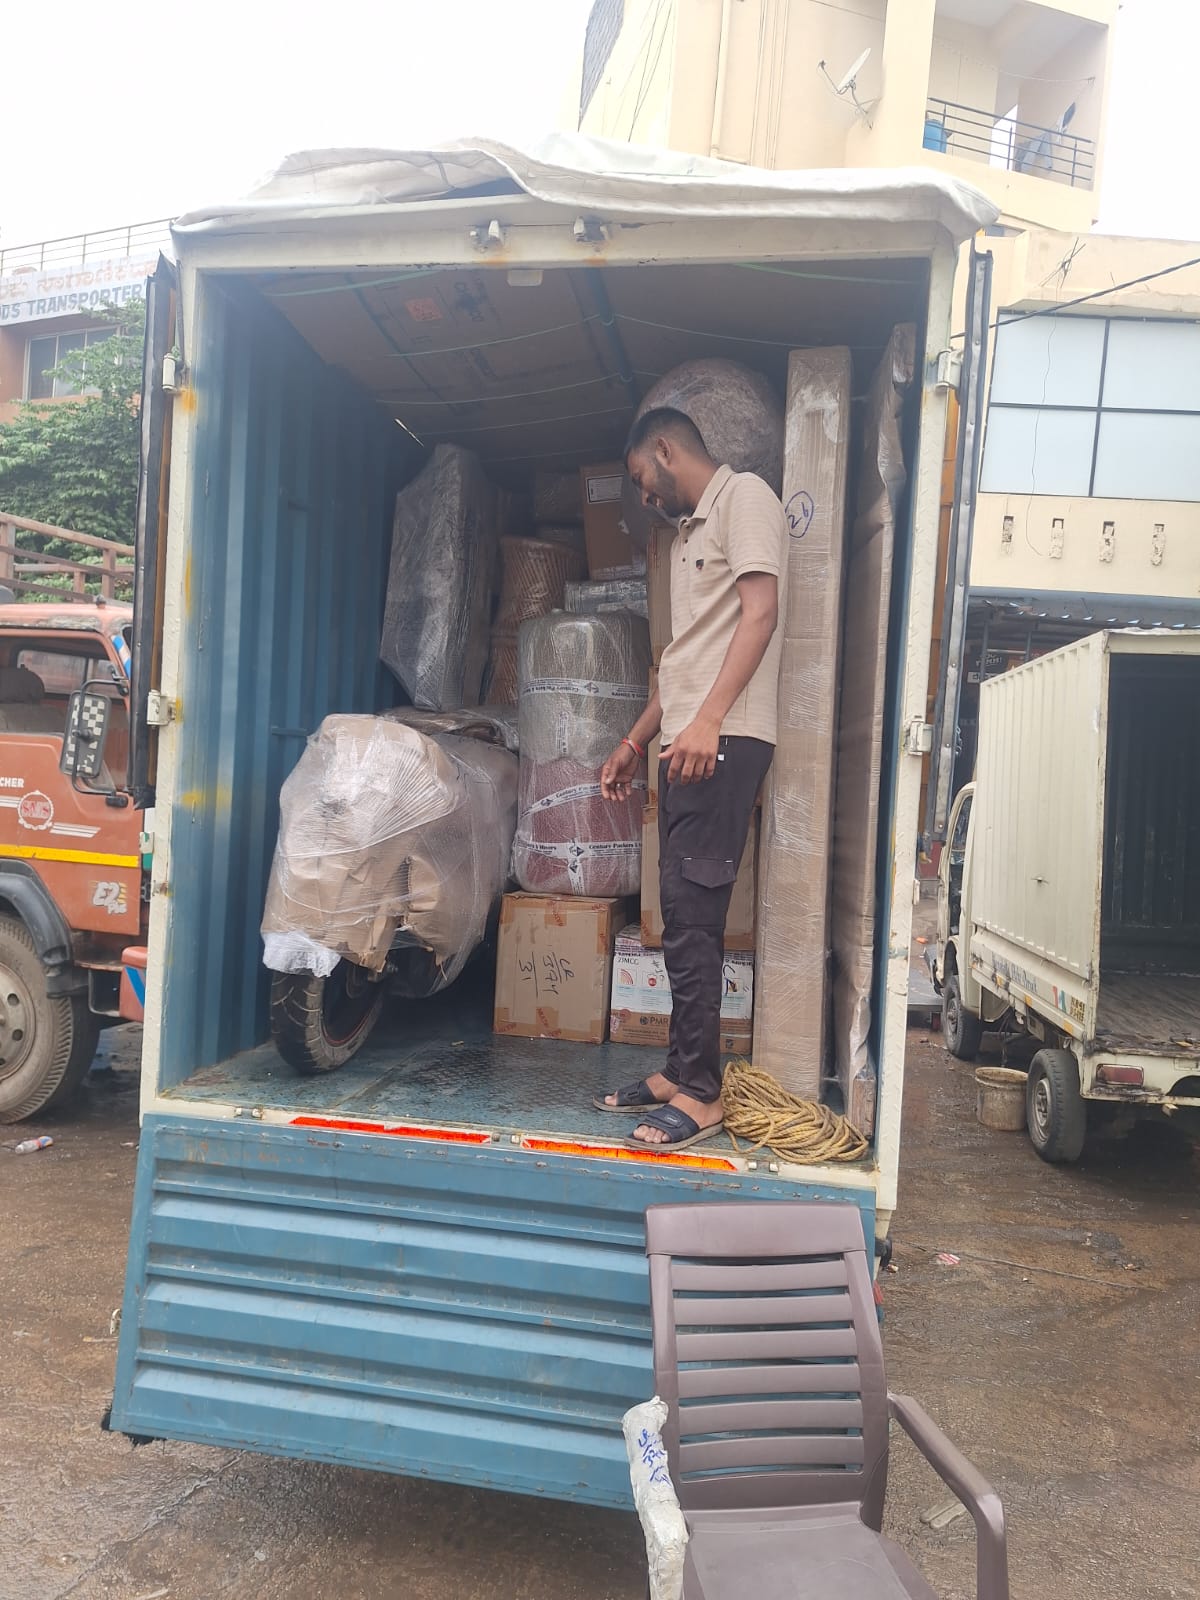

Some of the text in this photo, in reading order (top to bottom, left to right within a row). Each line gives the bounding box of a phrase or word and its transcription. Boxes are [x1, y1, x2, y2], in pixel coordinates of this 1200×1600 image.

[0, 281, 148, 320] DS TRANSPORTER
[0, 777, 25, 788] CHER
